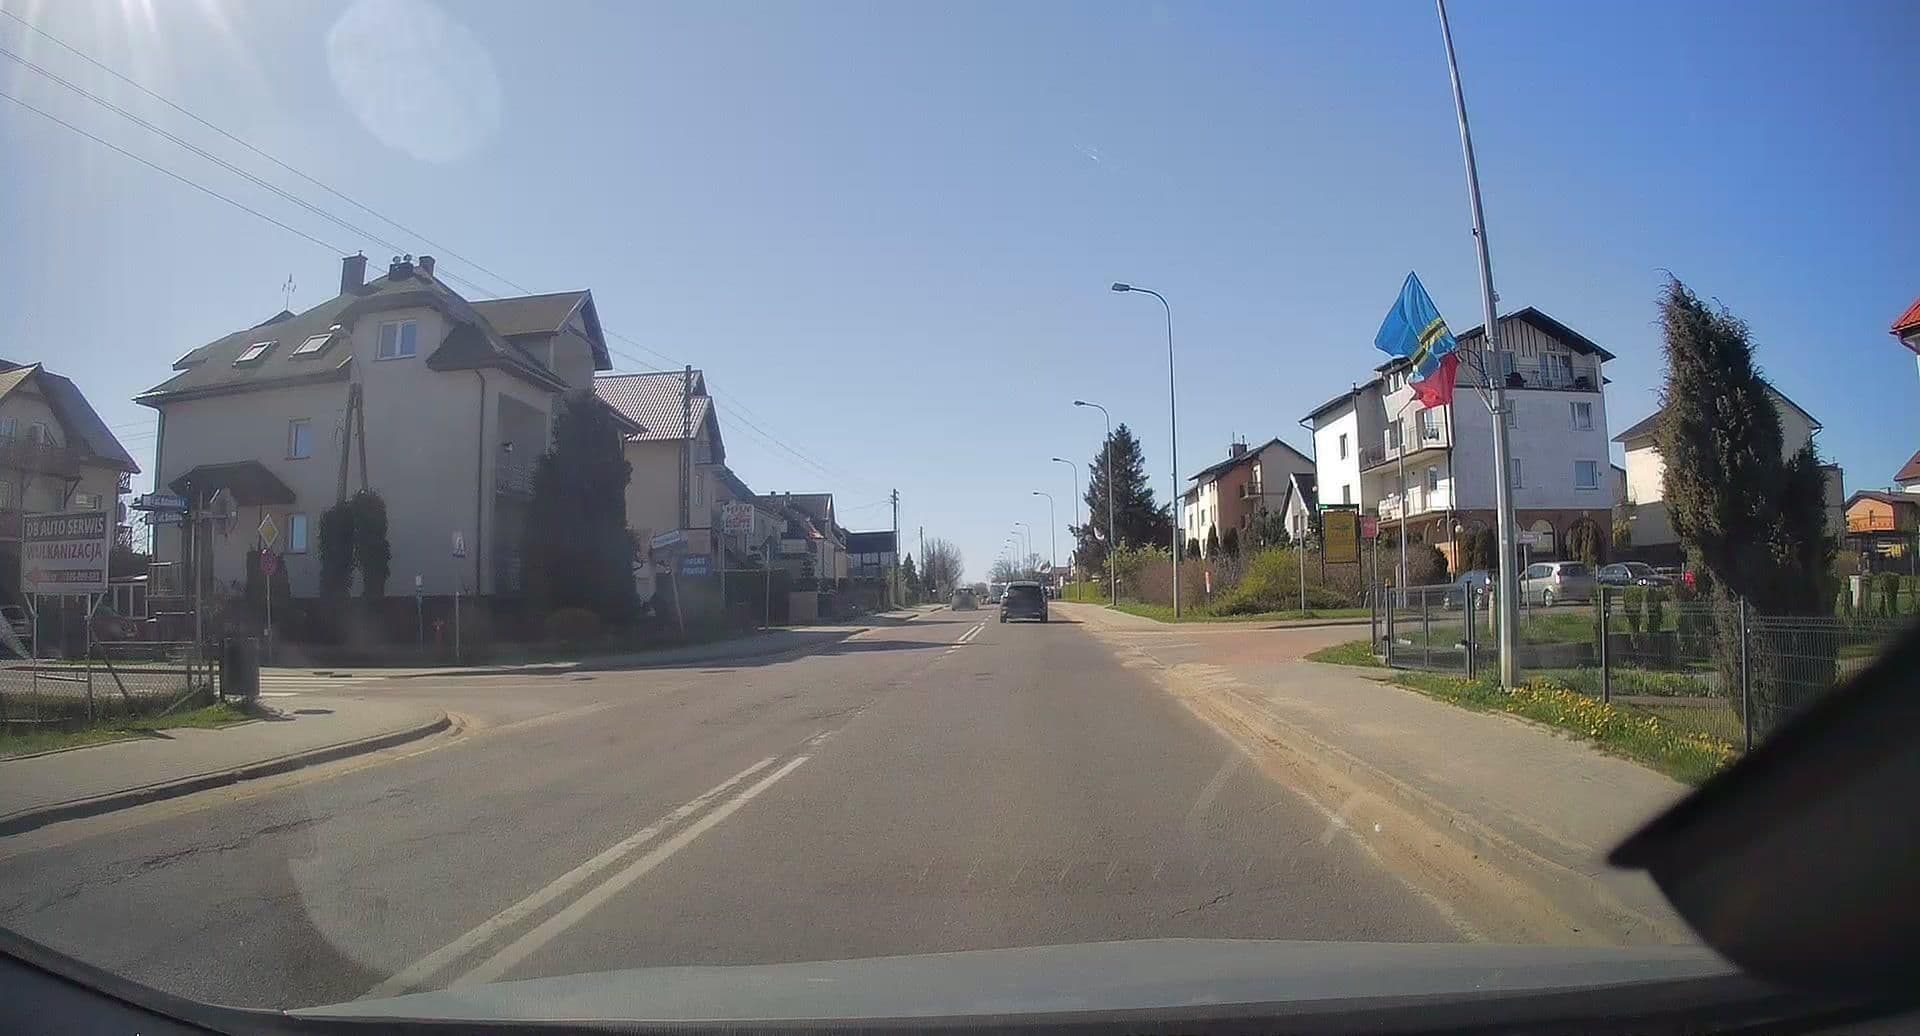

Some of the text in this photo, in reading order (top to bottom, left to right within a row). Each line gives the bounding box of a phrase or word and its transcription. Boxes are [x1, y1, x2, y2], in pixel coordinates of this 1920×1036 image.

[40, 519, 65, 536] AUTO
[67, 518, 104, 536] SERWIS
[24, 543, 103, 561] WULKANIZACJA
